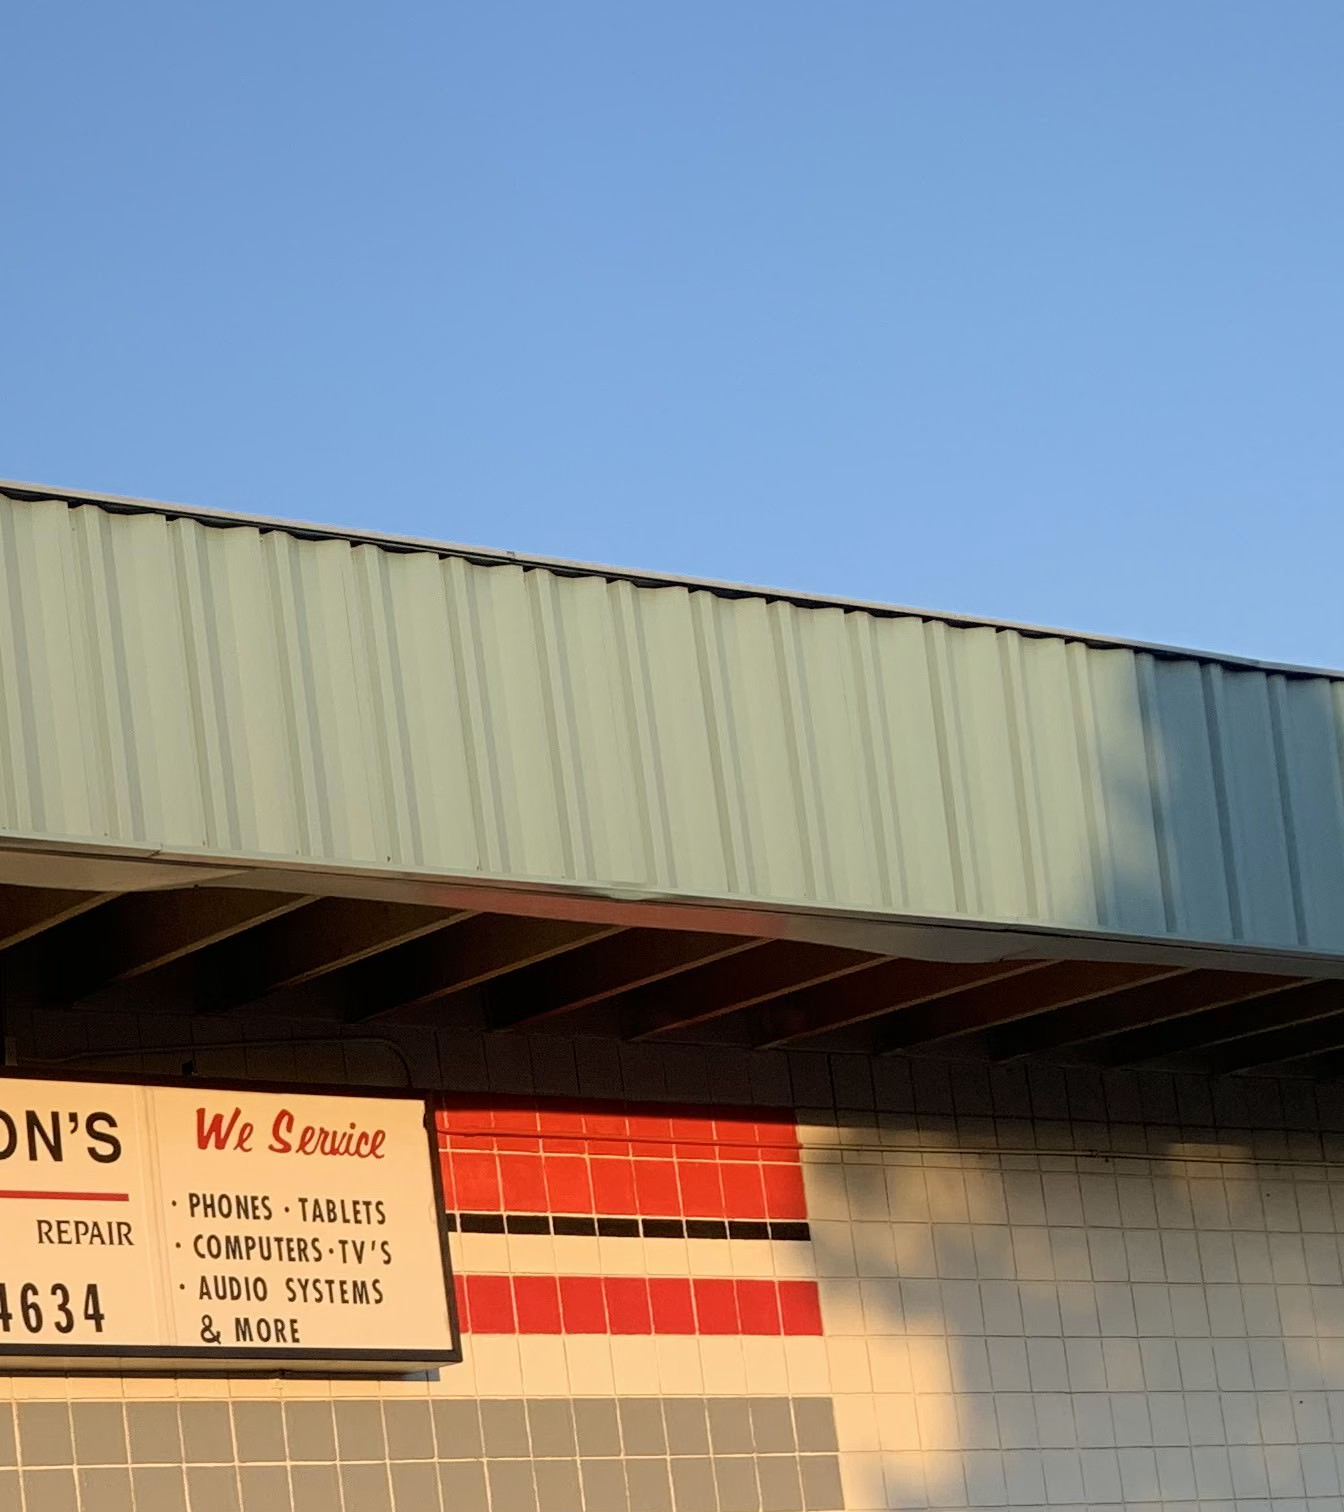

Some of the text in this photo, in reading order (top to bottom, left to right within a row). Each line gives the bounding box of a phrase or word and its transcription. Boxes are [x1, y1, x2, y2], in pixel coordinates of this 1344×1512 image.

[195, 1106, 387, 1159] We Service
[188, 1192, 386, 1225] PHONES TABLETS
[36, 1218, 136, 1248] REPAIR
[193, 1234, 393, 1265] COMPUTERS TV'S
[199, 1275, 384, 1305] AUDIO SYSTEMS
[200, 1314, 301, 1344] & MORE
